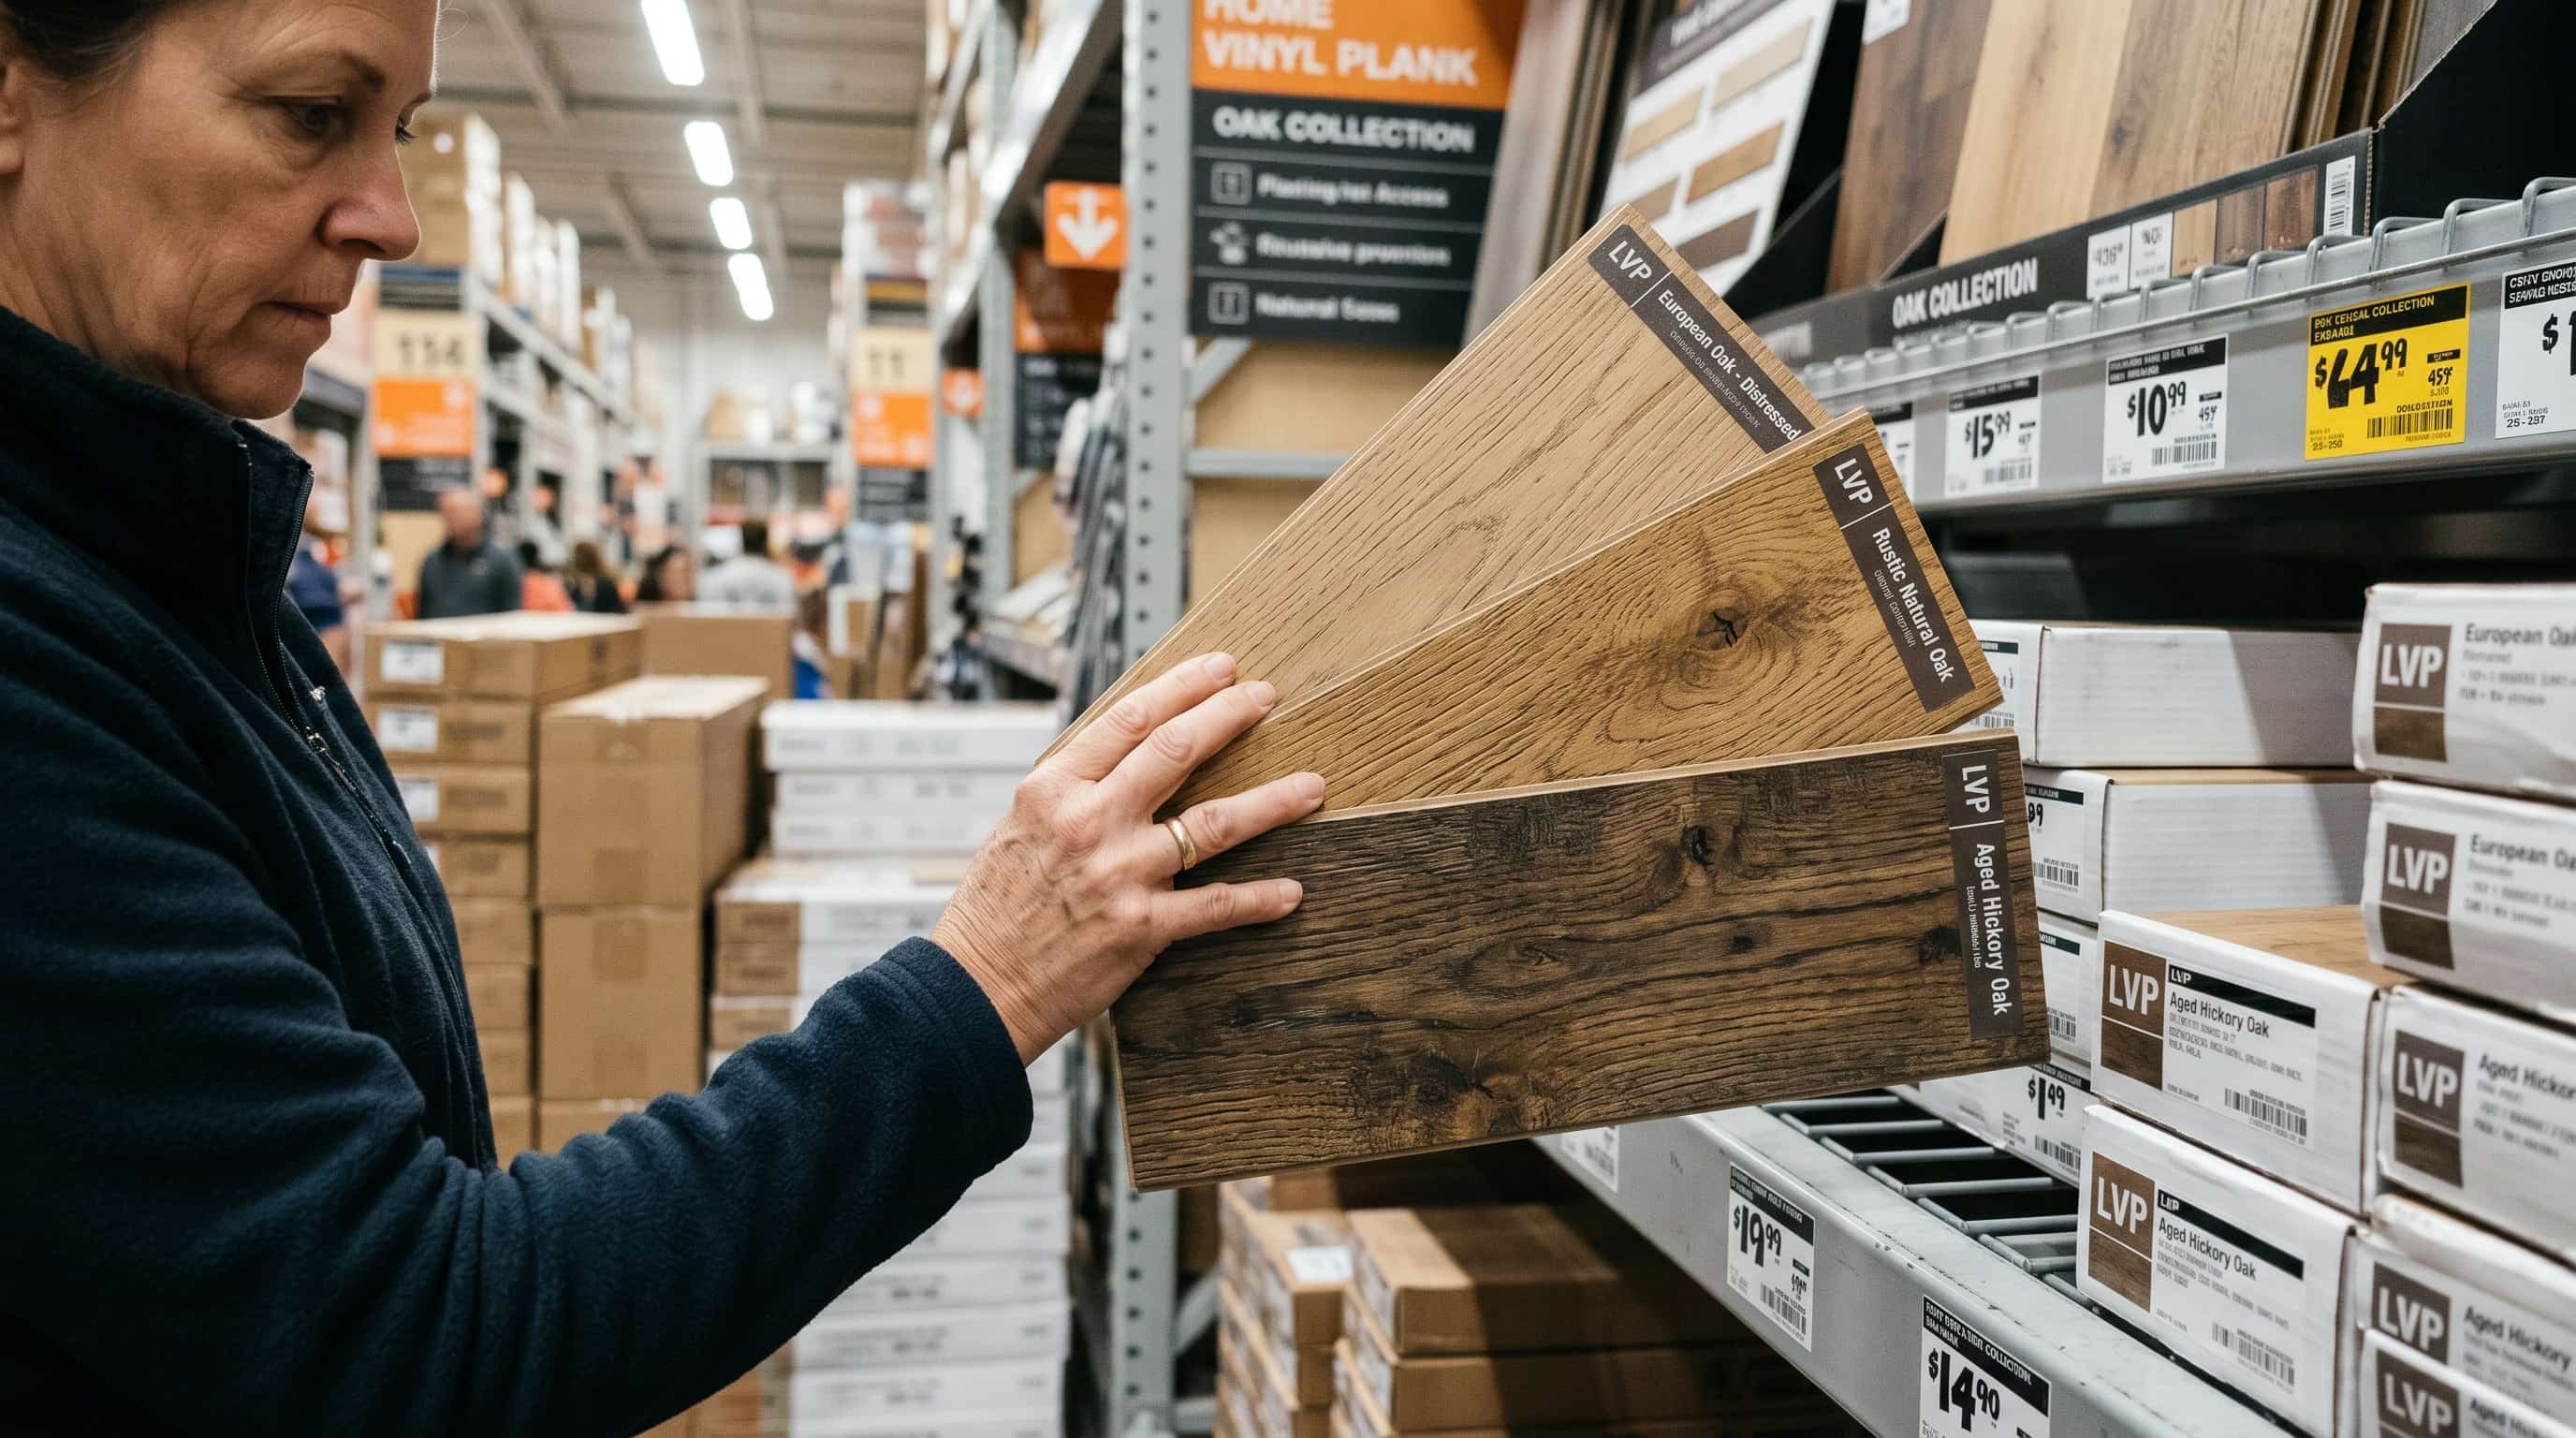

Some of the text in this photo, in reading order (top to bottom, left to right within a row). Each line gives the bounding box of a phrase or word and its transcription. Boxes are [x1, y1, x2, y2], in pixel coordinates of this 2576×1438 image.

[1204, 0, 1334, 29] HOME
[1202, 29, 1478, 86] VINYL PLANK
[1212, 105, 1476, 153] OAK COLLECTION
[1608, 241, 1652, 280] LVP
[1892, 288, 1927, 329] OAK
[1929, 257, 2038, 318] COLLECTION
[2372, 296, 2435, 317] COLLECTION
[1658, 289, 1713, 348] European
[1739, 375, 1802, 442] Distressed
[1834, 458, 1873, 506] LVP
[1872, 527, 1906, 582] Rustic
[1899, 582, 1939, 647] Natural
[1929, 648, 1954, 682] Oak
[2465, 623, 2543, 648] European
[2380, 643, 2443, 689] LVP
[1961, 764, 1990, 814] LVP
[2387, 844, 2449, 894] LVP
[2470, 833, 2548, 865] European
[1974, 844, 2012, 1015] Aged Hickory Oak
[2109, 964, 2159, 1016] LVP
[2171, 967, 2192, 985] LVP
[2170, 991, 2270, 1038] Aged Hickory Oak
[2397, 1051, 2458, 1108] LVP
[2097, 1176, 2147, 1235] LVP
[2159, 1217, 2257, 1281] Aged Hickory Oak
[2378, 1285, 2445, 1351] LVP
[2508, 1324, 2571, 1372] Hickory
[2385, 1372, 2453, 1435] LVP
